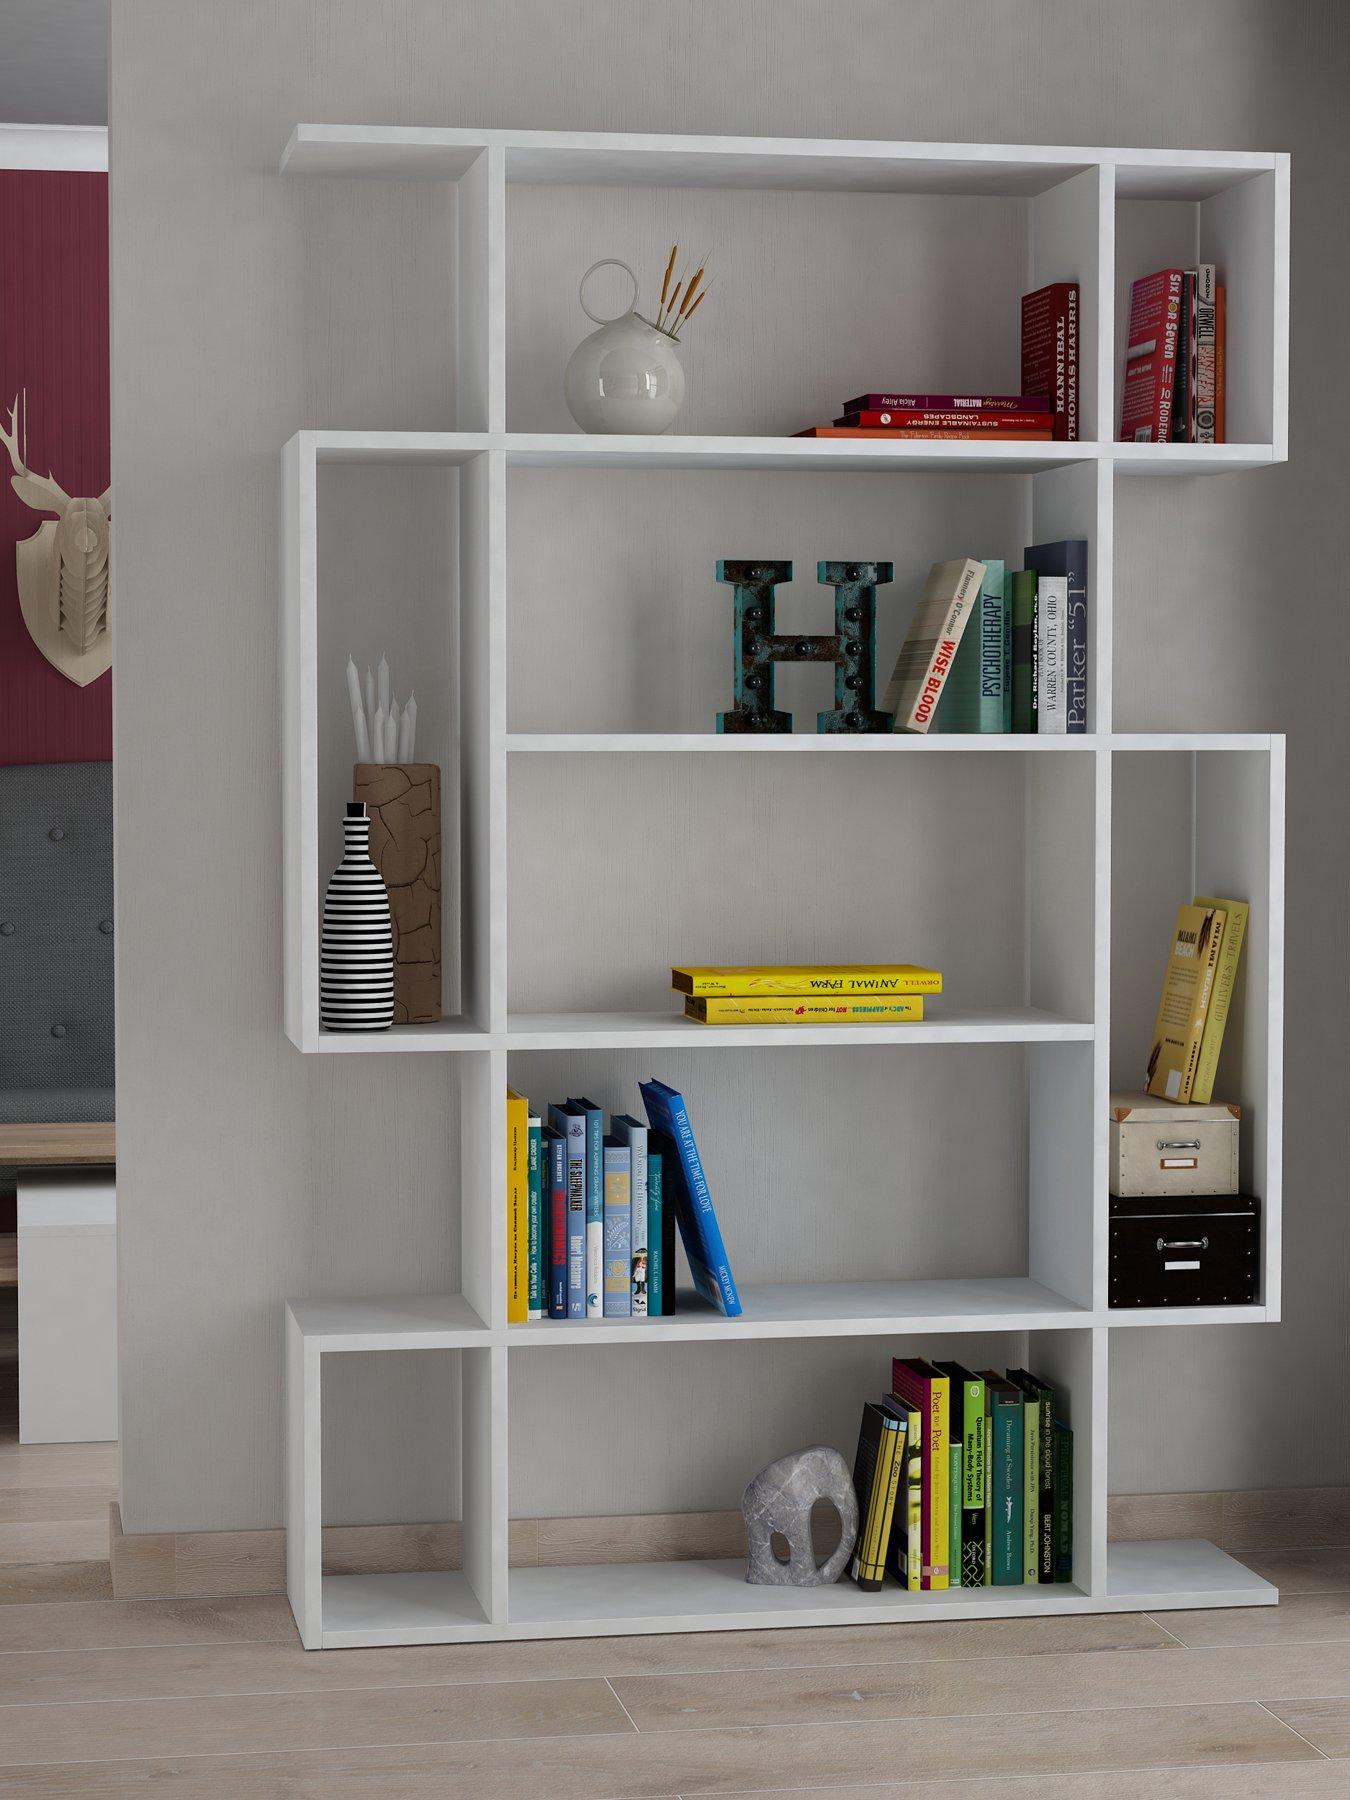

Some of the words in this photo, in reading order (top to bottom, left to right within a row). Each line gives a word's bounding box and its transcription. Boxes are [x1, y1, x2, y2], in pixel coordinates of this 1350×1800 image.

[1068, 289, 1077, 362] HARRIS
[1199, 308, 1215, 339] ORWELL
[1056, 316, 1065, 413] HANNIBAL
[899, 398, 917, 407] Alicia
[954, 399, 983, 408] MATERIAL
[1068, 364, 1077, 441] THOMAS
[956, 568, 975, 602] Flannery
[1046, 595, 1057, 620] OHIO
[943, 601, 963, 637] O'Connor
[716, 560, 893, 734] H
[982, 594, 1002, 698] PSYCHOTHERAPY
[1046, 622, 1058, 667] COUNTY,
[931, 640, 957, 677] WISE
[1046, 670, 1057, 711] WARREN
[1065, 638, 1087, 726] Parker
[912, 676, 942, 725] BLOOD
[1207, 921, 1222, 968] MIAMI
[1227, 911, 1243, 958] TRAVELS
[809, 979, 843, 990] FARM
[848, 978, 900, 989] ANIMAL
[675, 1109, 688, 1126] YOU
[679, 1125, 692, 1140] ARE
[569, 1158, 583, 1170] THE
[685, 1149, 699, 1164] THE
[689, 1162, 703, 1181] TIME
[569, 1170, 583, 1212] SLEEPWALKER
[695, 1180, 707, 1196] FOR
[699, 1194, 713, 1214] LOVE
[530, 1214, 539, 1224] your
[530, 1224, 538, 1240] become
[570, 1235, 584, 1255] Robert
[530, 1262, 538, 1274] Cells
[718, 1265, 729, 1284] MICKEY
[530, 1274, 538, 1285] Your
[529, 1290, 538, 1300] Talk
[931, 1391, 942, 1414] Poet
[931, 1429, 942, 1453] Poet
[1004, 1419, 1013, 1453] Dreaming
[1045, 1436, 1053, 1448] the
[966, 1433, 974, 1471] Many-Body
[1045, 1448, 1053, 1468] cloud
[966, 1473, 974, 1502] Systems
[975, 1469, 983, 1491] Theory
[1045, 1468, 1053, 1489] forest
[976, 1493, 983, 1502] of
[1044, 1514, 1052, 1532] BERT
[1059, 1500, 1069, 1554] NOMAD
[1043, 1532, 1052, 1573] JOHNSTON
